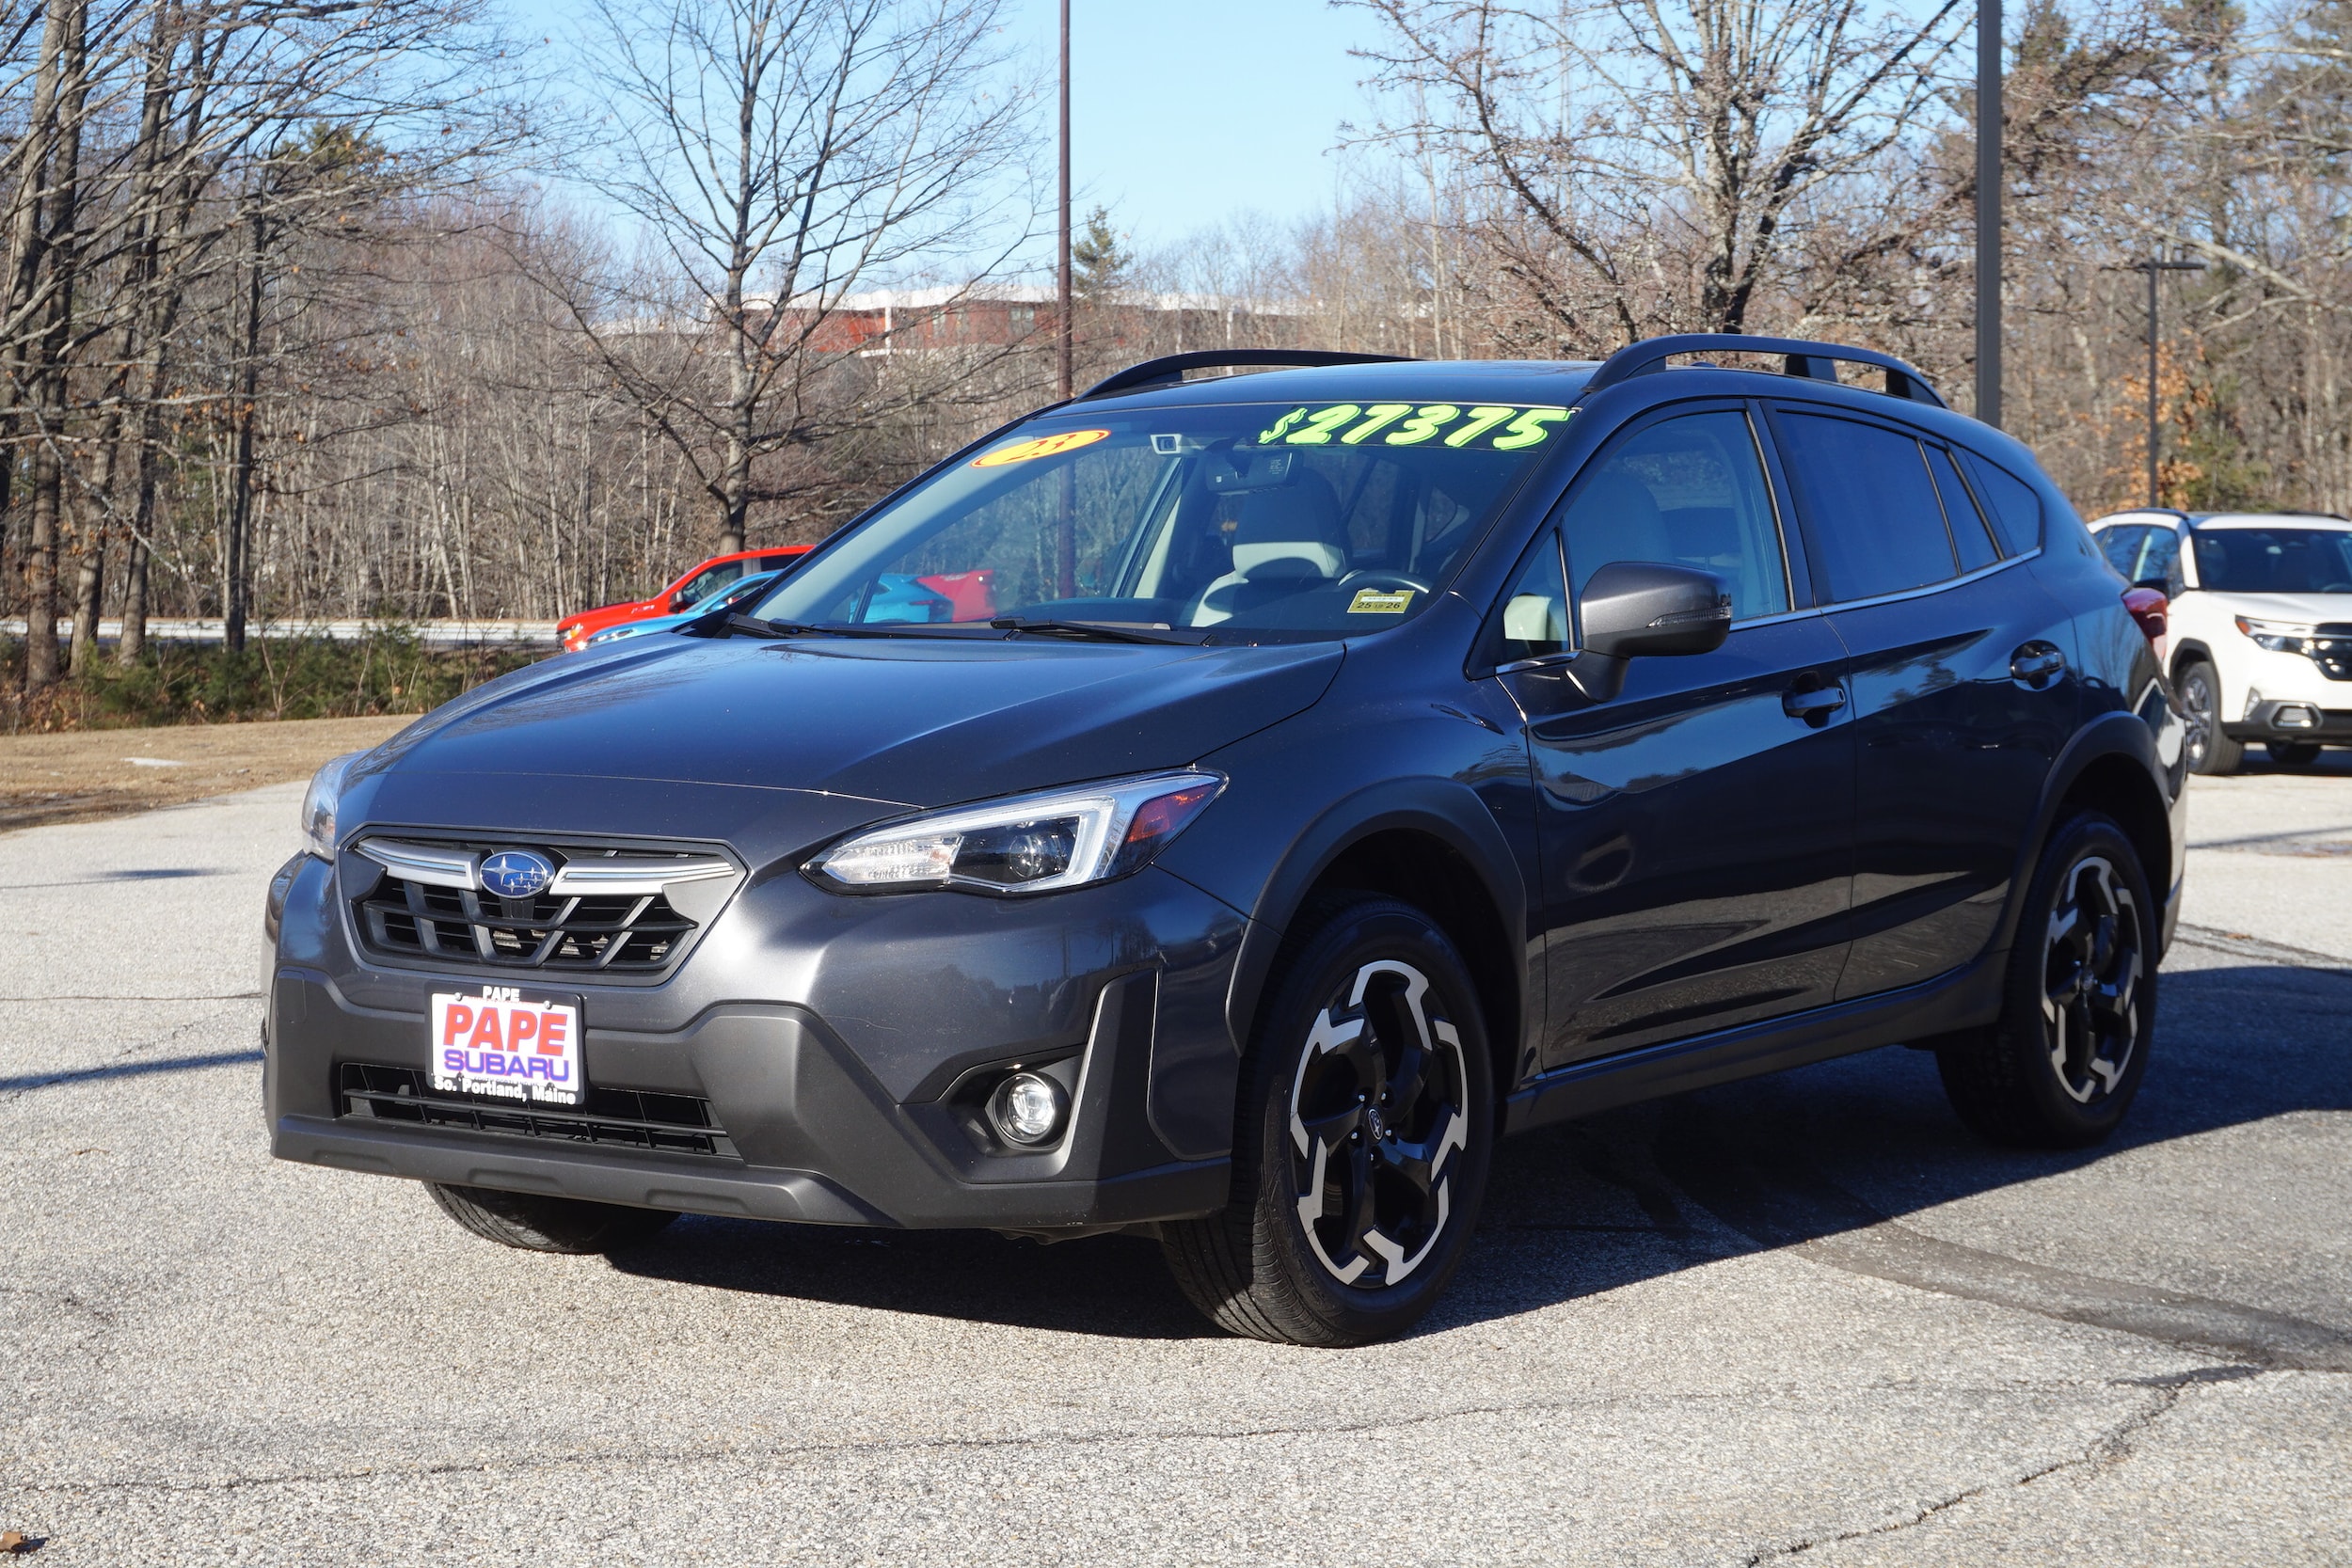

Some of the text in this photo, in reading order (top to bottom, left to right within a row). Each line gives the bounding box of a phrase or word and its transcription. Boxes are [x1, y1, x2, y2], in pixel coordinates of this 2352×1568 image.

[1258, 404, 1572, 450] $27375
[483, 986, 519, 1001] PAPE
[443, 1004, 567, 1056] PAPE
[444, 1049, 569, 1082] SUBARU
[434, 1075, 456, 1091] So.
[462, 1078, 527, 1102] Portland,
[532, 1085, 576, 1105] Maine
